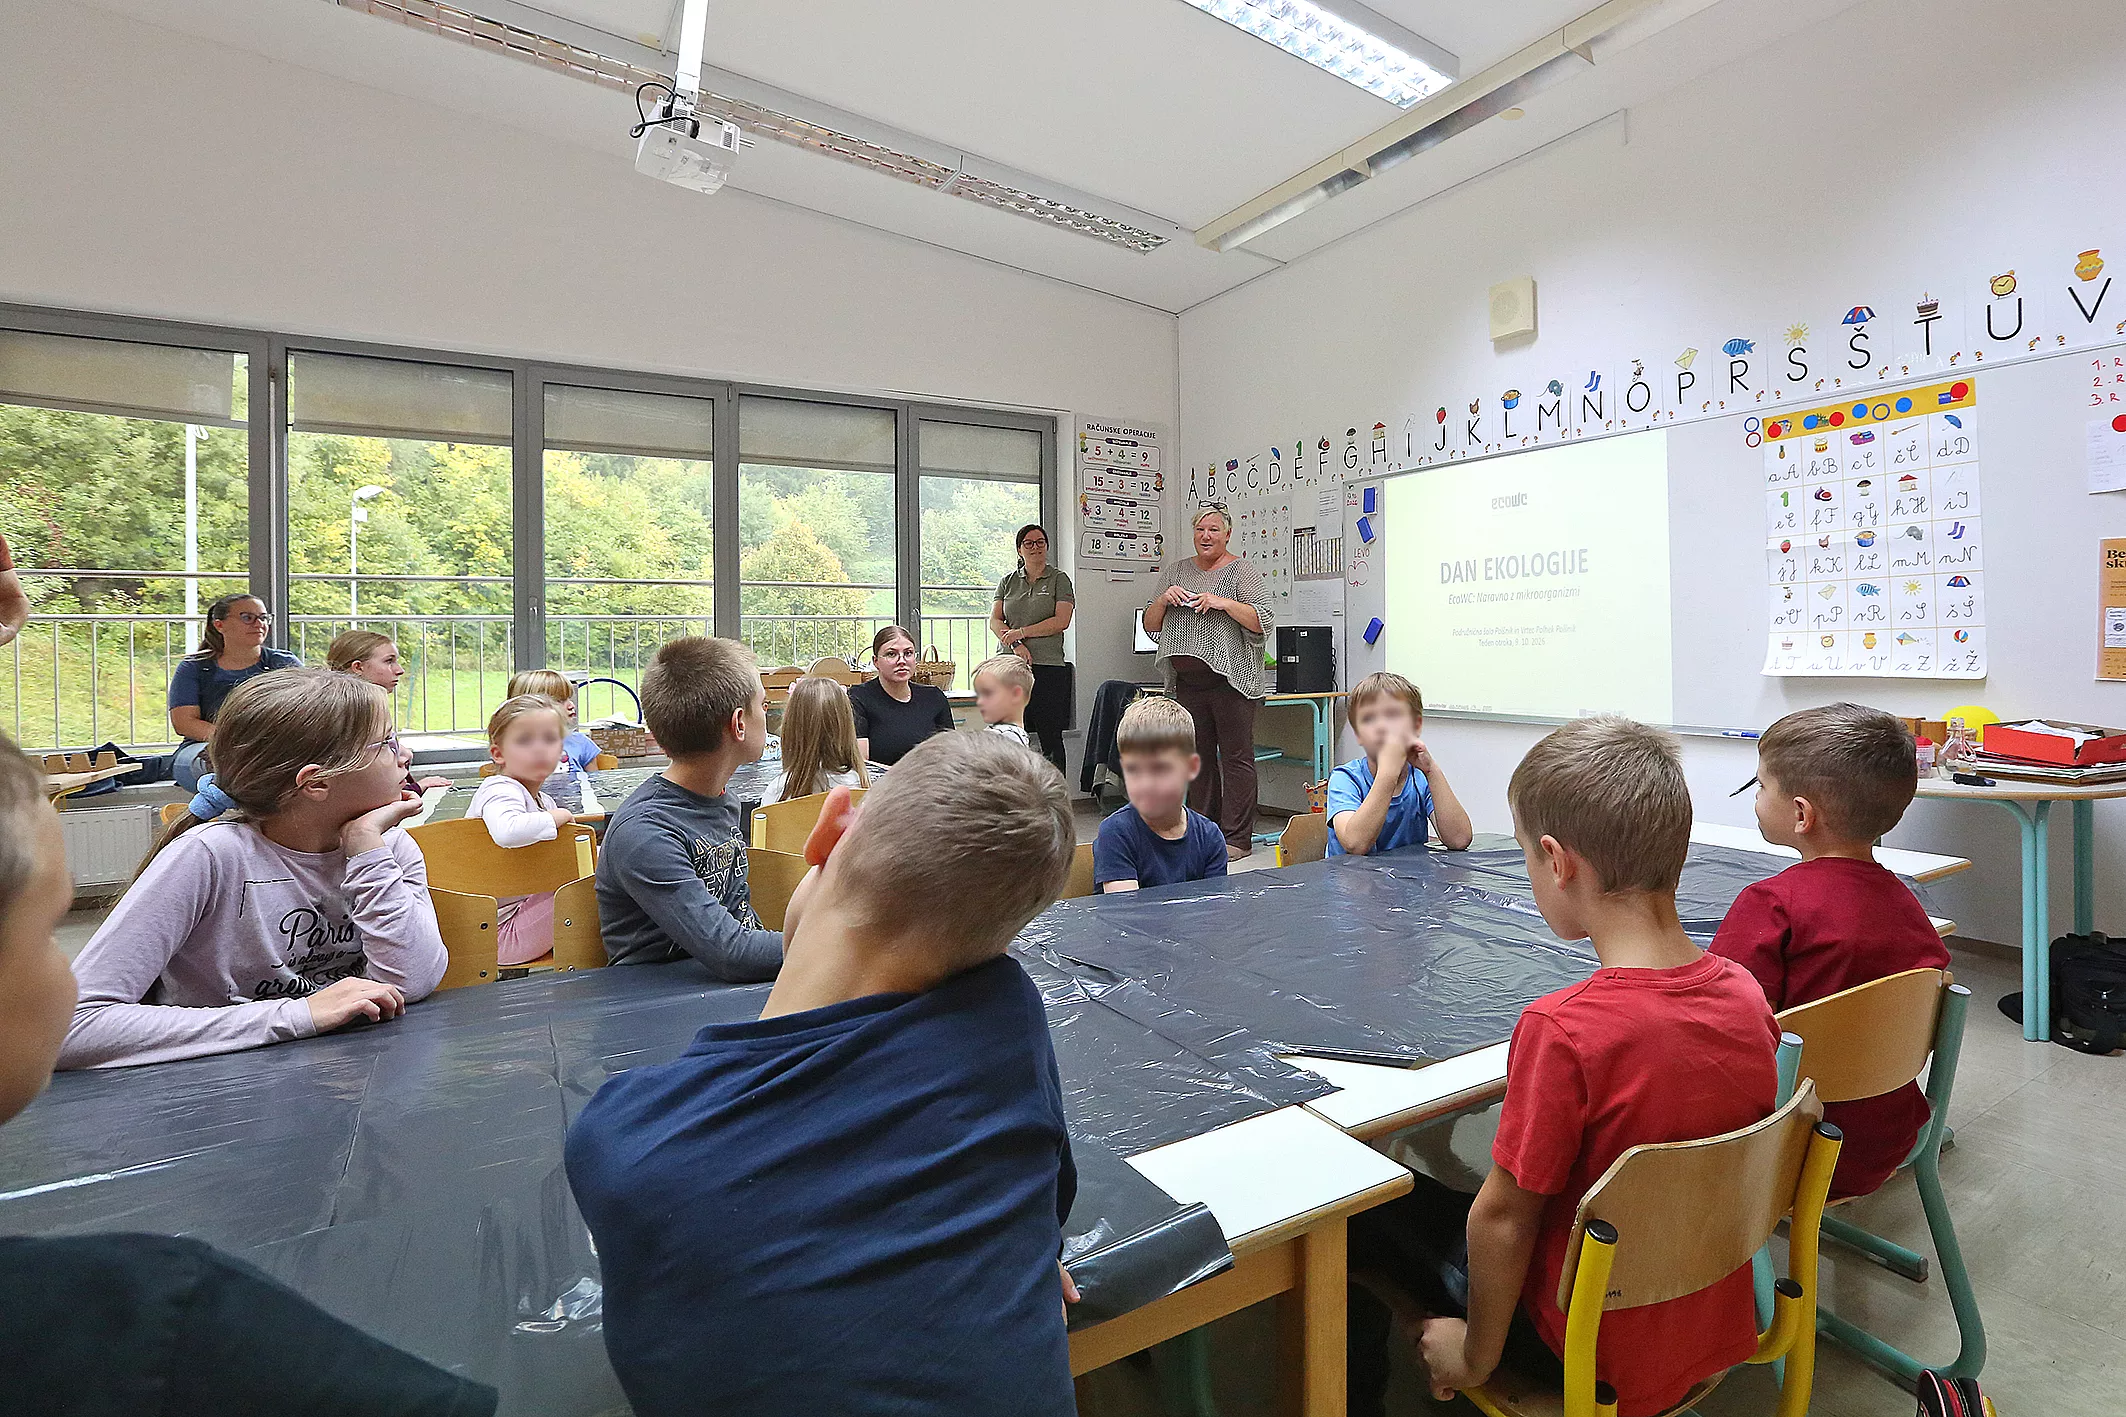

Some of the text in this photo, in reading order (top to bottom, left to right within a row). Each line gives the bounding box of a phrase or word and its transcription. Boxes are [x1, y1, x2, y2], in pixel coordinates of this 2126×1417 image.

[2114, 357, 2124, 367] R
[2116, 373, 2125, 383] R
[1188, 481, 1199, 501] A
[1208, 477, 1216, 498] B
[1227, 472, 1238, 493] C
[1247, 463, 1259, 489] Č
[1269, 463, 1281, 486] D
[1295, 457, 1304, 480] E
[1320, 452, 1329, 476] F
[1344, 446, 1358, 470] G
[1372, 438, 1387, 465] H
[1435, 425, 1446, 452] J
[1468, 418, 1482, 446] K
[1505, 411, 1517, 439] L
[1539, 400, 1561, 432] M
[1583, 390, 1603, 423] N
[1627, 381, 1651, 413] O
[1678, 372, 1695, 405] P
[1730, 360, 1749, 394] R
[1787, 347, 1808, 382] S
[1848, 326, 1871, 370] Š
[1914, 314, 1943, 356] T
[1987, 297, 2022, 341] U
[2068, 277, 2112, 324] V
[2110, 392, 2121, 401] R
[1086, 423, 1156, 439] RAČUNSKE OPERACIJE
[1095, 446, 1101, 456] 5
[1118, 450, 1125, 459] 4
[1142, 452, 1148, 462] 9
[1094, 476, 1103, 486] 15
[1119, 480, 1124, 489] 3
[1141, 482, 1149, 493] 12
[1095, 505, 1101, 515] 3
[1119, 508, 1124, 517] 4
[1140, 510, 1149, 520] 12
[1091, 539, 1101, 549] 18
[1119, 541, 1124, 551] 6
[1142, 543, 1148, 553] 3
[1354, 548, 1370, 558] LEVO
[1441, 549, 1589, 584] DAN EKOLOGIJE
[1477, 592, 1509, 603] Naravno
[1516, 586, 1580, 601] mikroorganizmi
[279, 908, 354, 951] Paris
